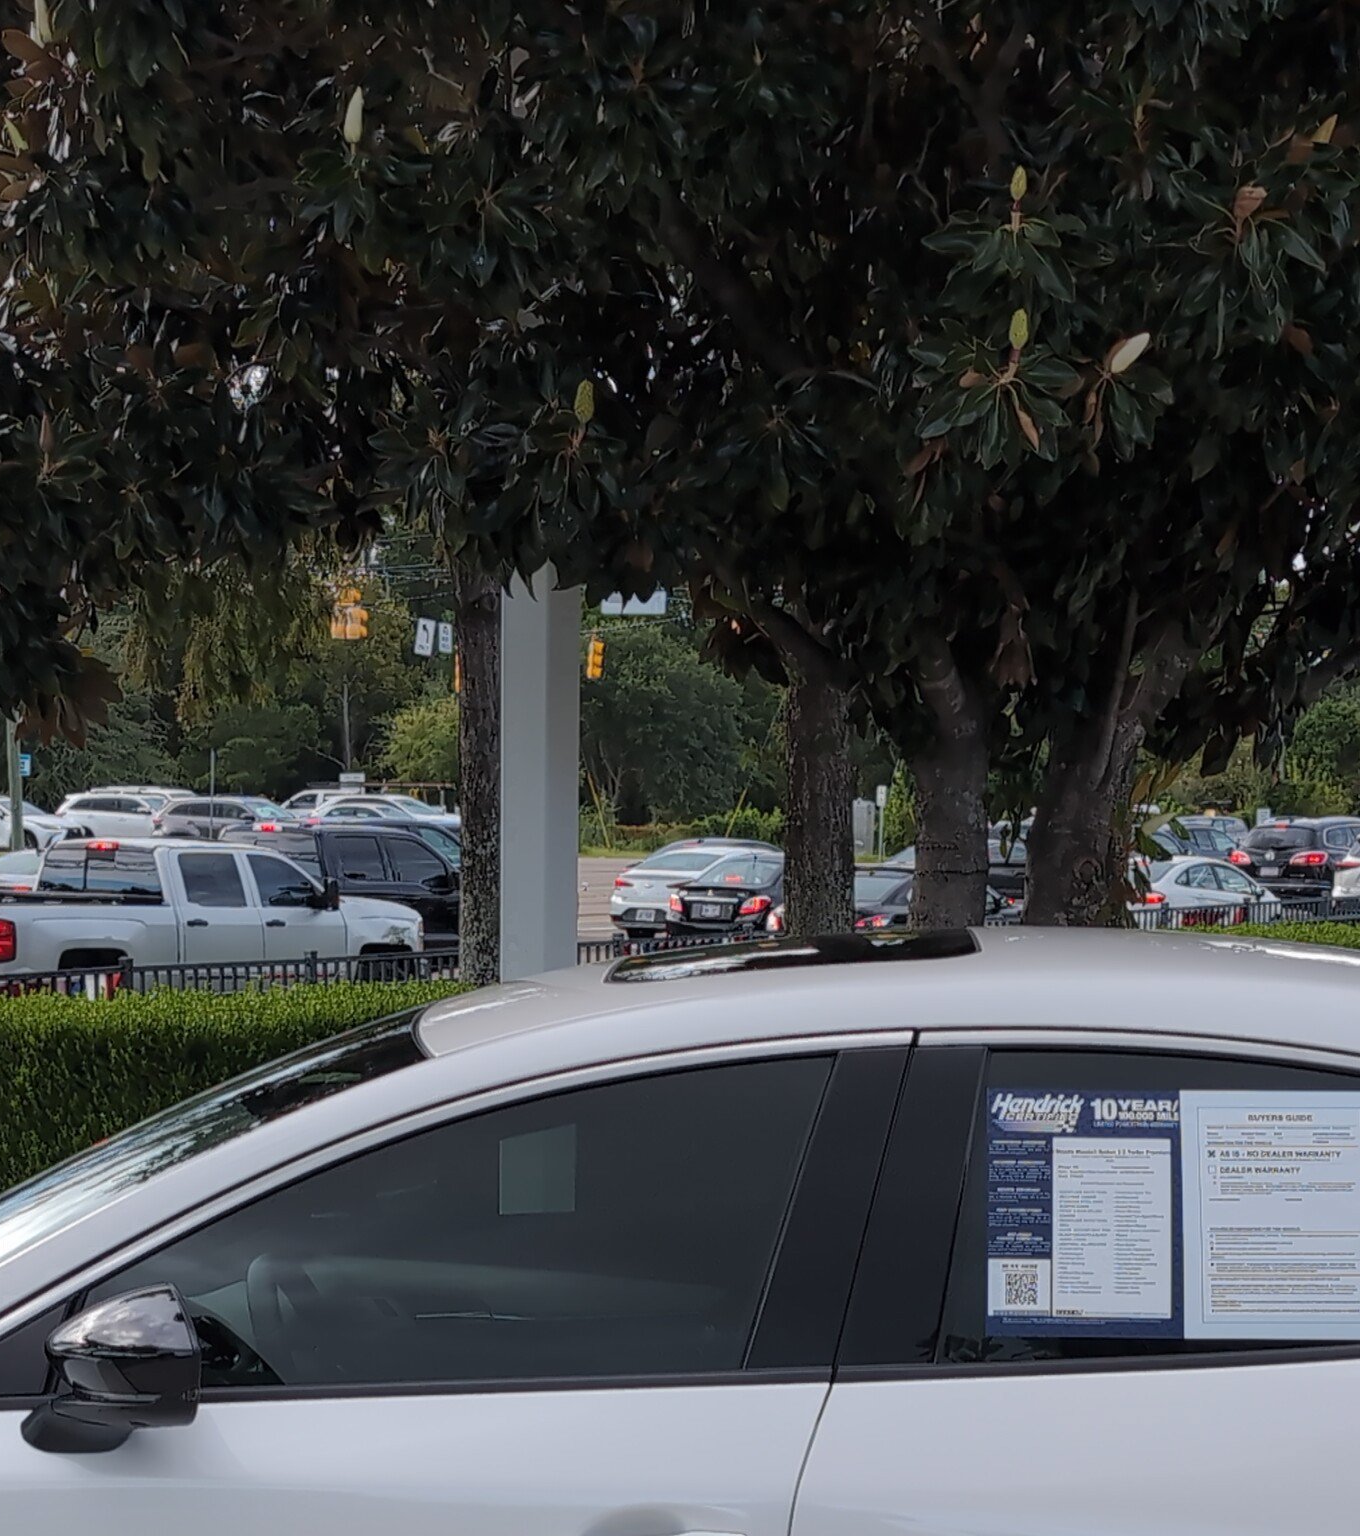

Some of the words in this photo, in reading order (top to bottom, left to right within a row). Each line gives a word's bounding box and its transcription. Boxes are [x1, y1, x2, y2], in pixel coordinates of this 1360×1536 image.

[991, 1093, 1085, 1120] Hendrick
[1091, 1098, 1118, 1121] 10
[1005, 1112, 1079, 1122] CERTIFIED
[1248, 1114, 1283, 1122] BUYERS
[1285, 1114, 1313, 1122] GUIDE
[1220, 1150, 1231, 1158] AS
[1247, 1150, 1259, 1158] NO
[1261, 1150, 1293, 1158] DEALER
[1295, 1150, 1342, 1158] WARRANTY
[1220, 1166, 1253, 1174] DEALER
[1255, 1166, 1301, 1174] WARRANTY
